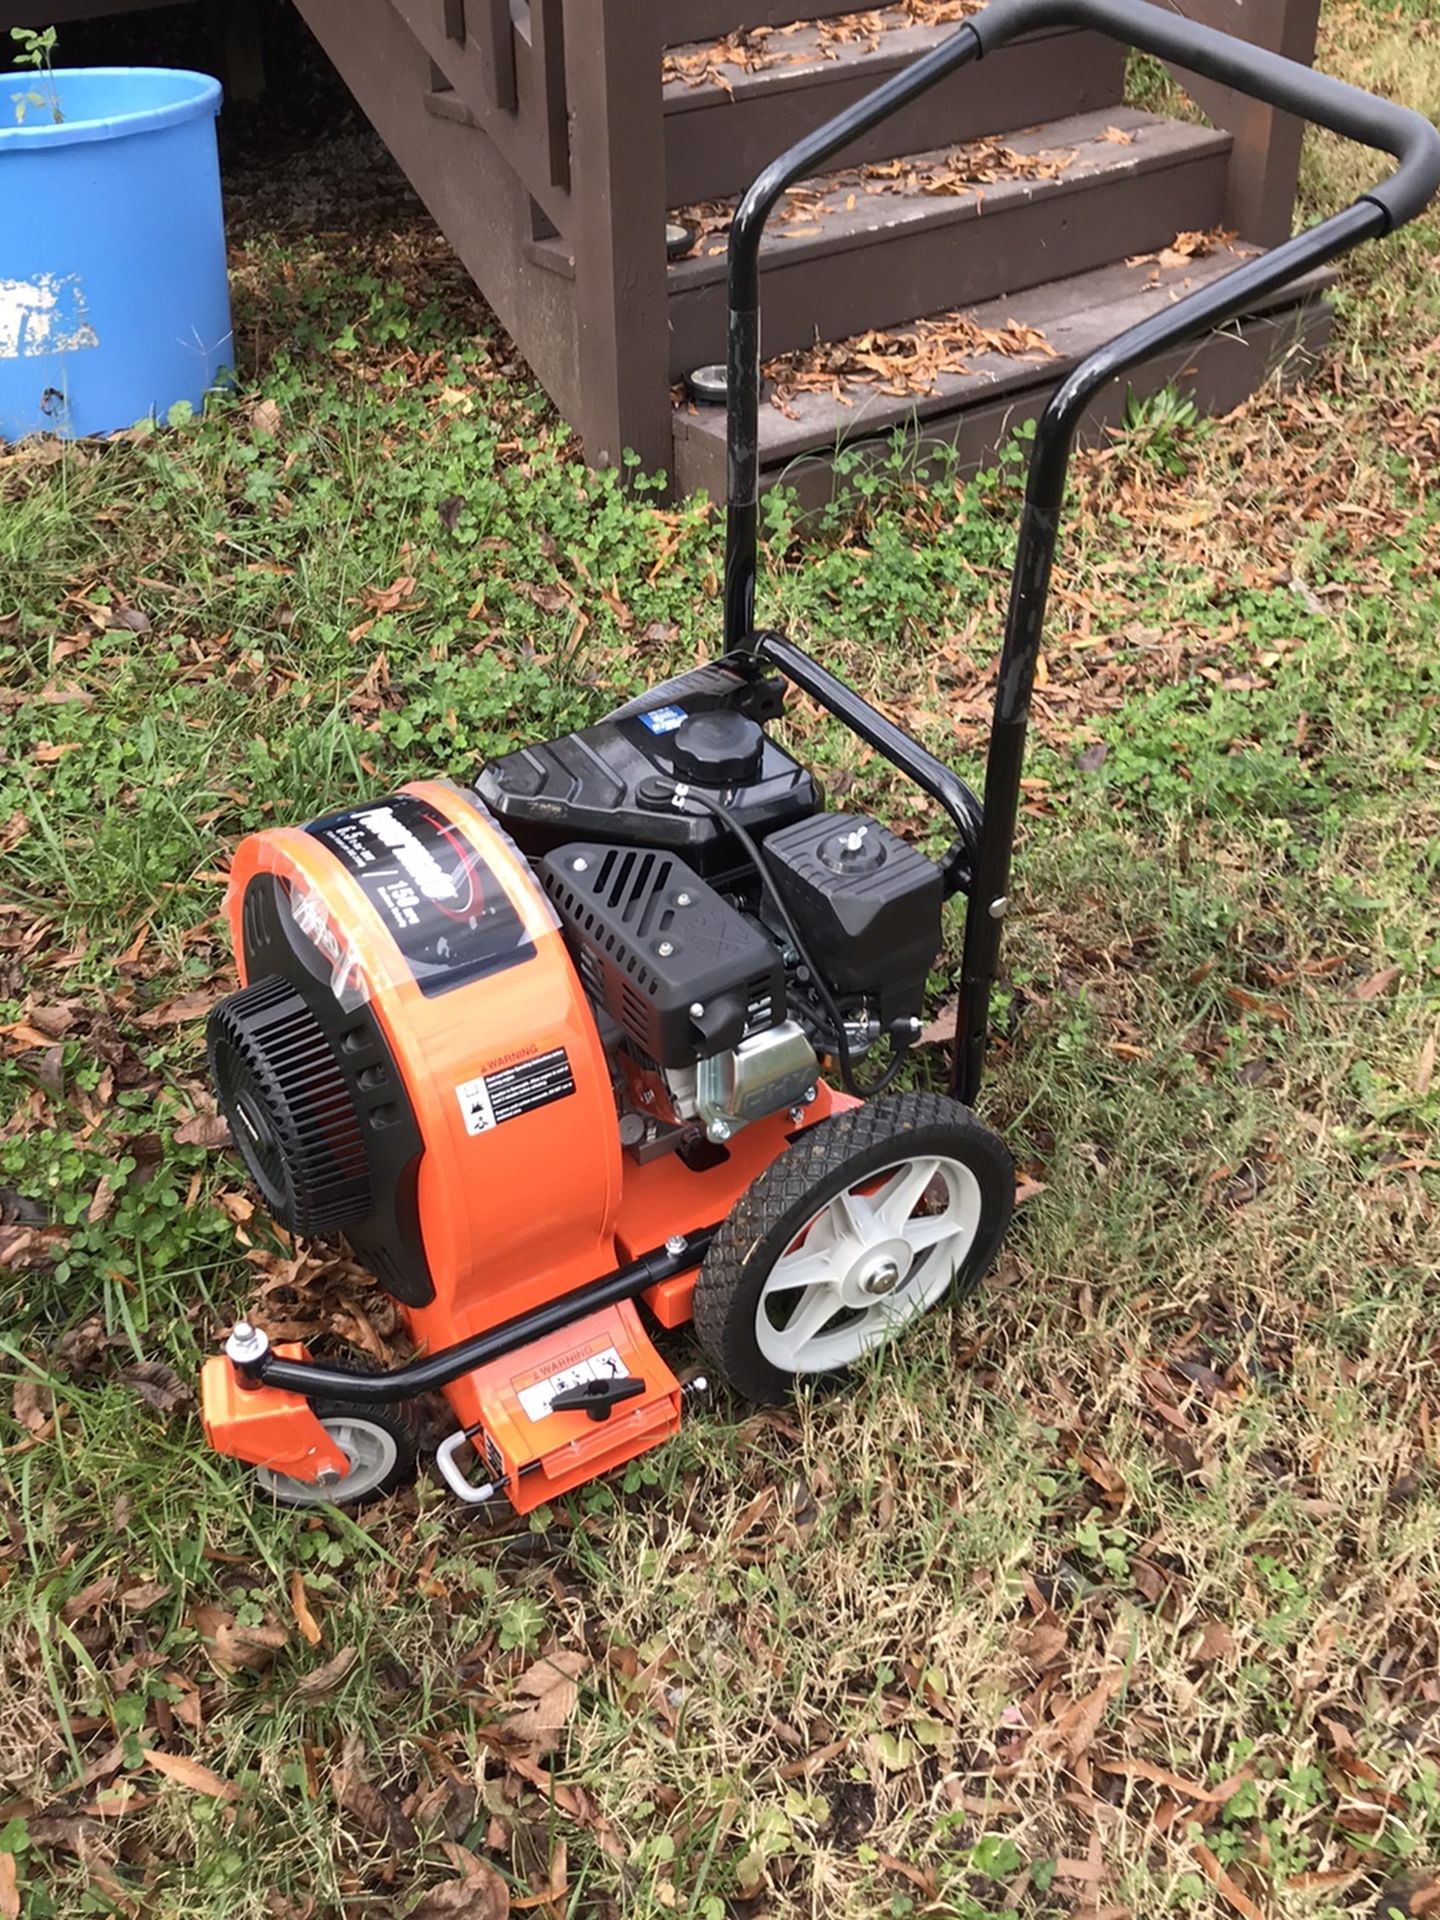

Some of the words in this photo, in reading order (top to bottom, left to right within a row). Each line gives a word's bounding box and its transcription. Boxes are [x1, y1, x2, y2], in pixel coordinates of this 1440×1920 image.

[387, 879, 420, 907] 150
[488, 1044, 538, 1068] WARNING
[540, 1346, 593, 1375] WARNING
